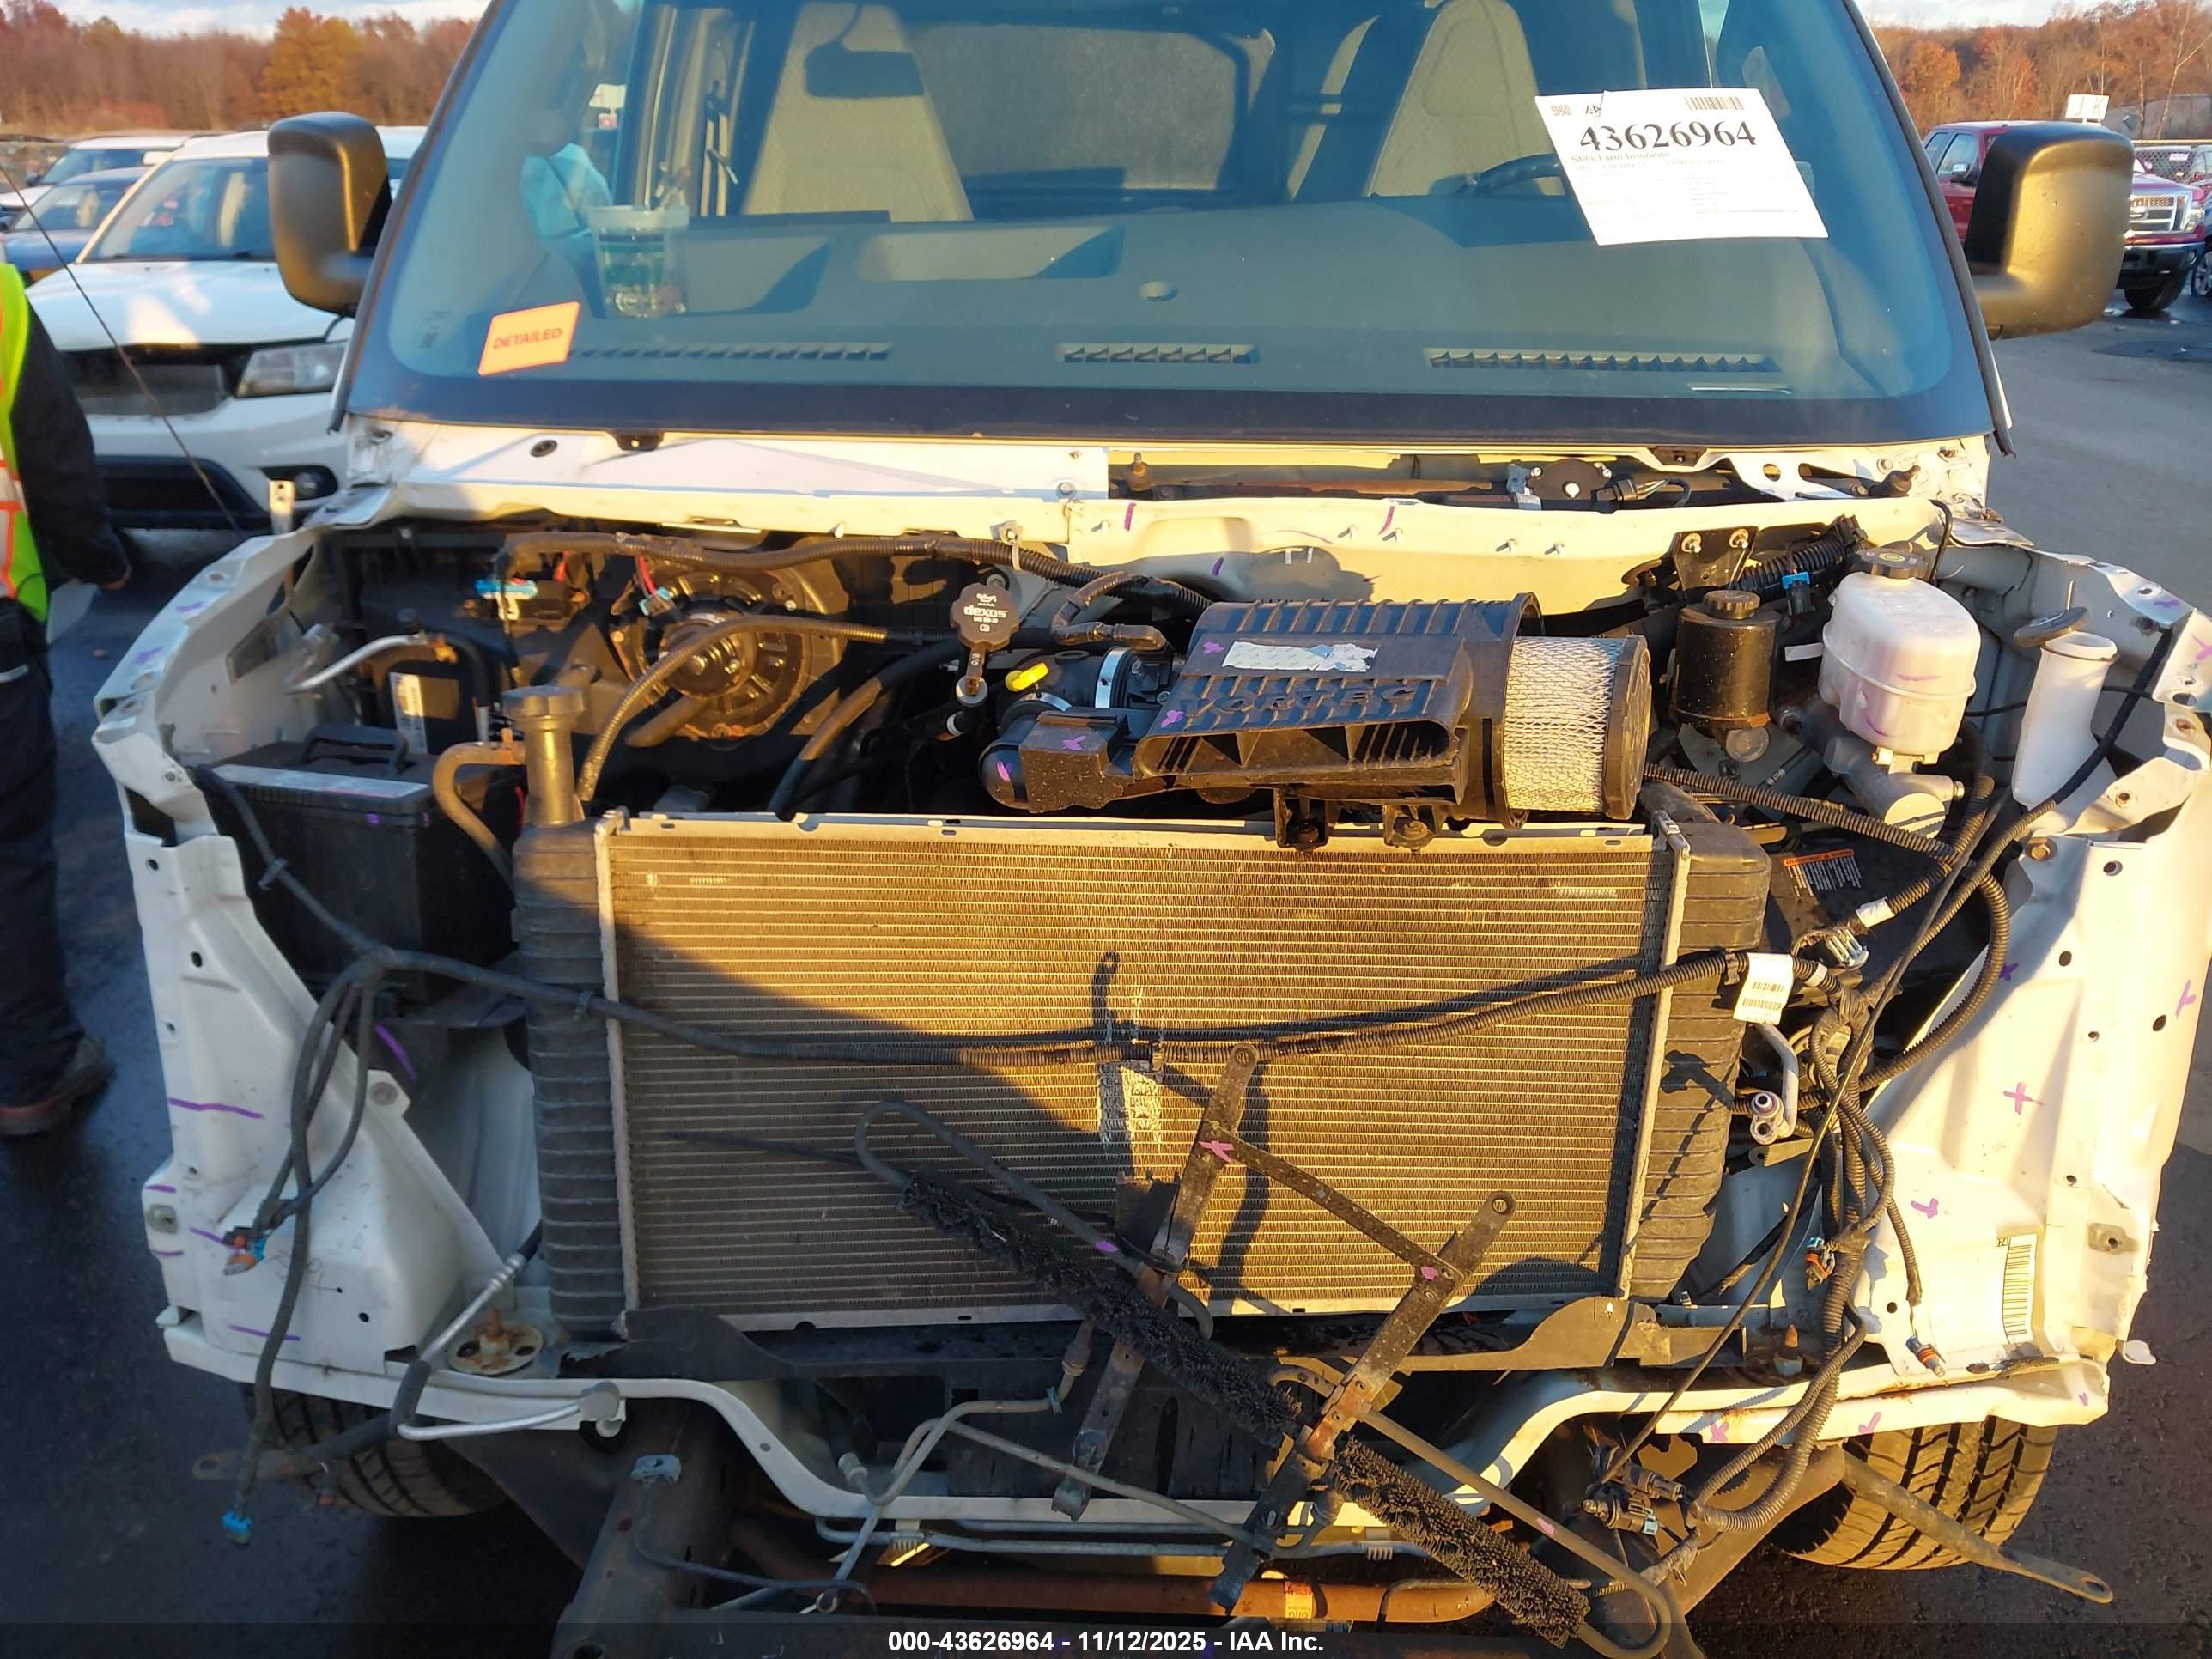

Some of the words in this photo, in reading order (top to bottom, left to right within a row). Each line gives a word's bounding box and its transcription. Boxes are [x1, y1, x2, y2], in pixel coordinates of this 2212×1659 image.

[1580, 120, 1757, 151] 43626964
[492, 327, 564, 349] DETAILED
[963, 605, 1008, 618] dexos
[1179, 684, 1416, 719] VORTEC
